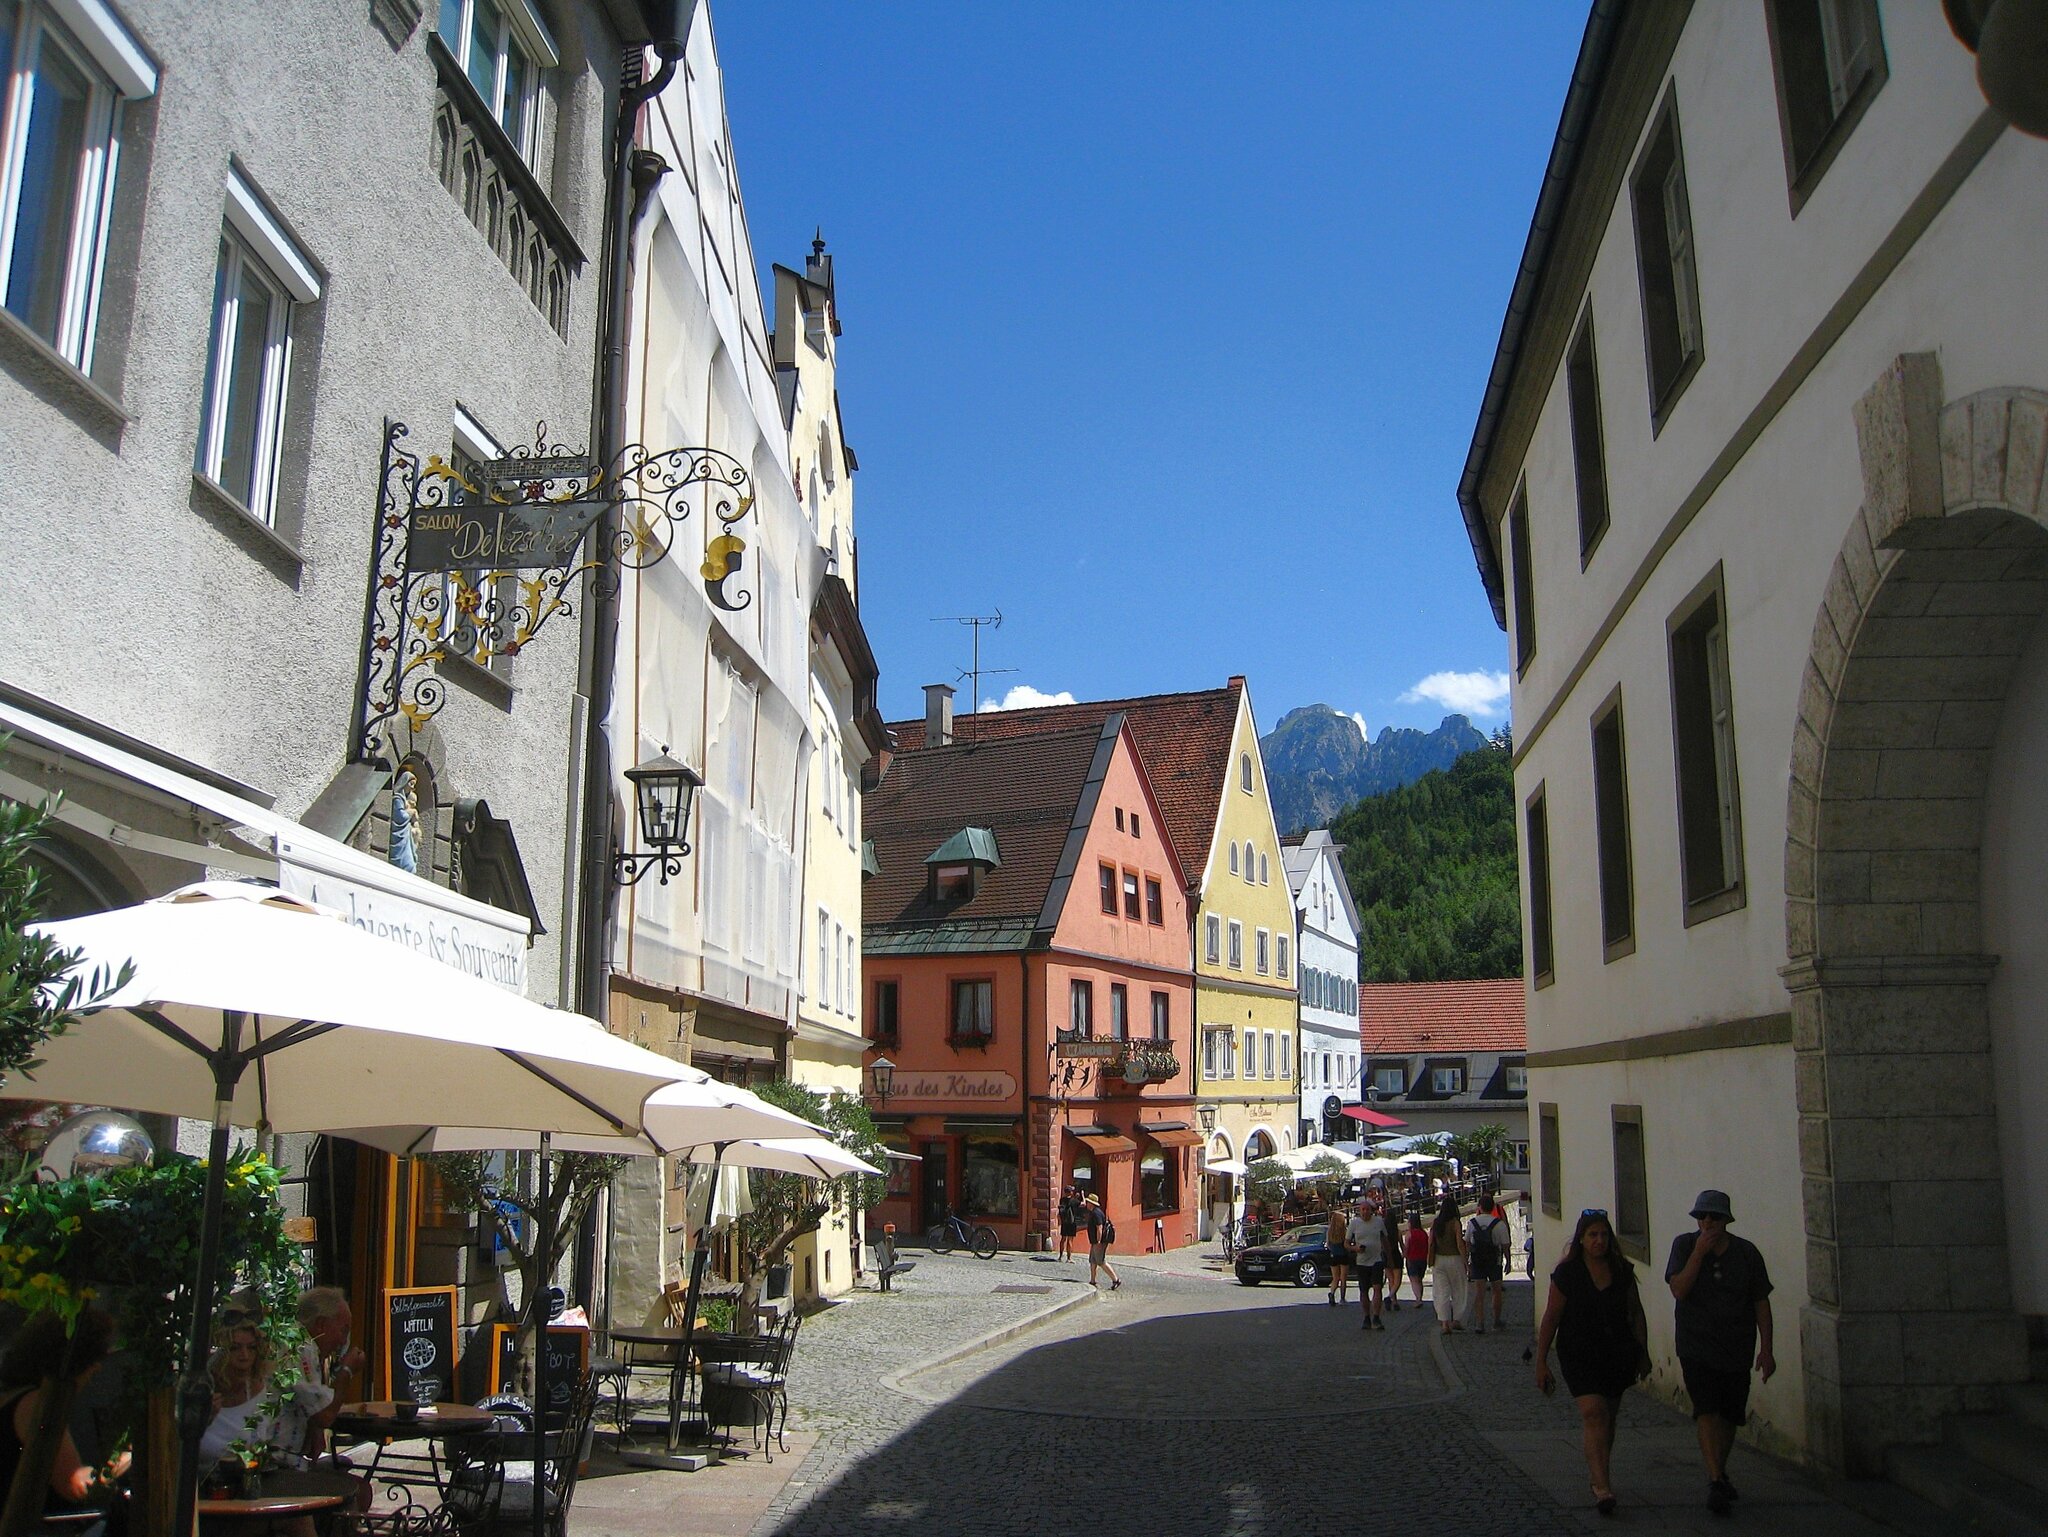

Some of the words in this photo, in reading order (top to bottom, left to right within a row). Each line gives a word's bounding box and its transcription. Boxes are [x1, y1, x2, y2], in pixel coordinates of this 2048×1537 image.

[415, 513, 461, 530] SALON
[451, 926, 519, 987] Souvenir
[913, 1078, 939, 1098] des
[943, 1074, 1004, 1098] Kindes
